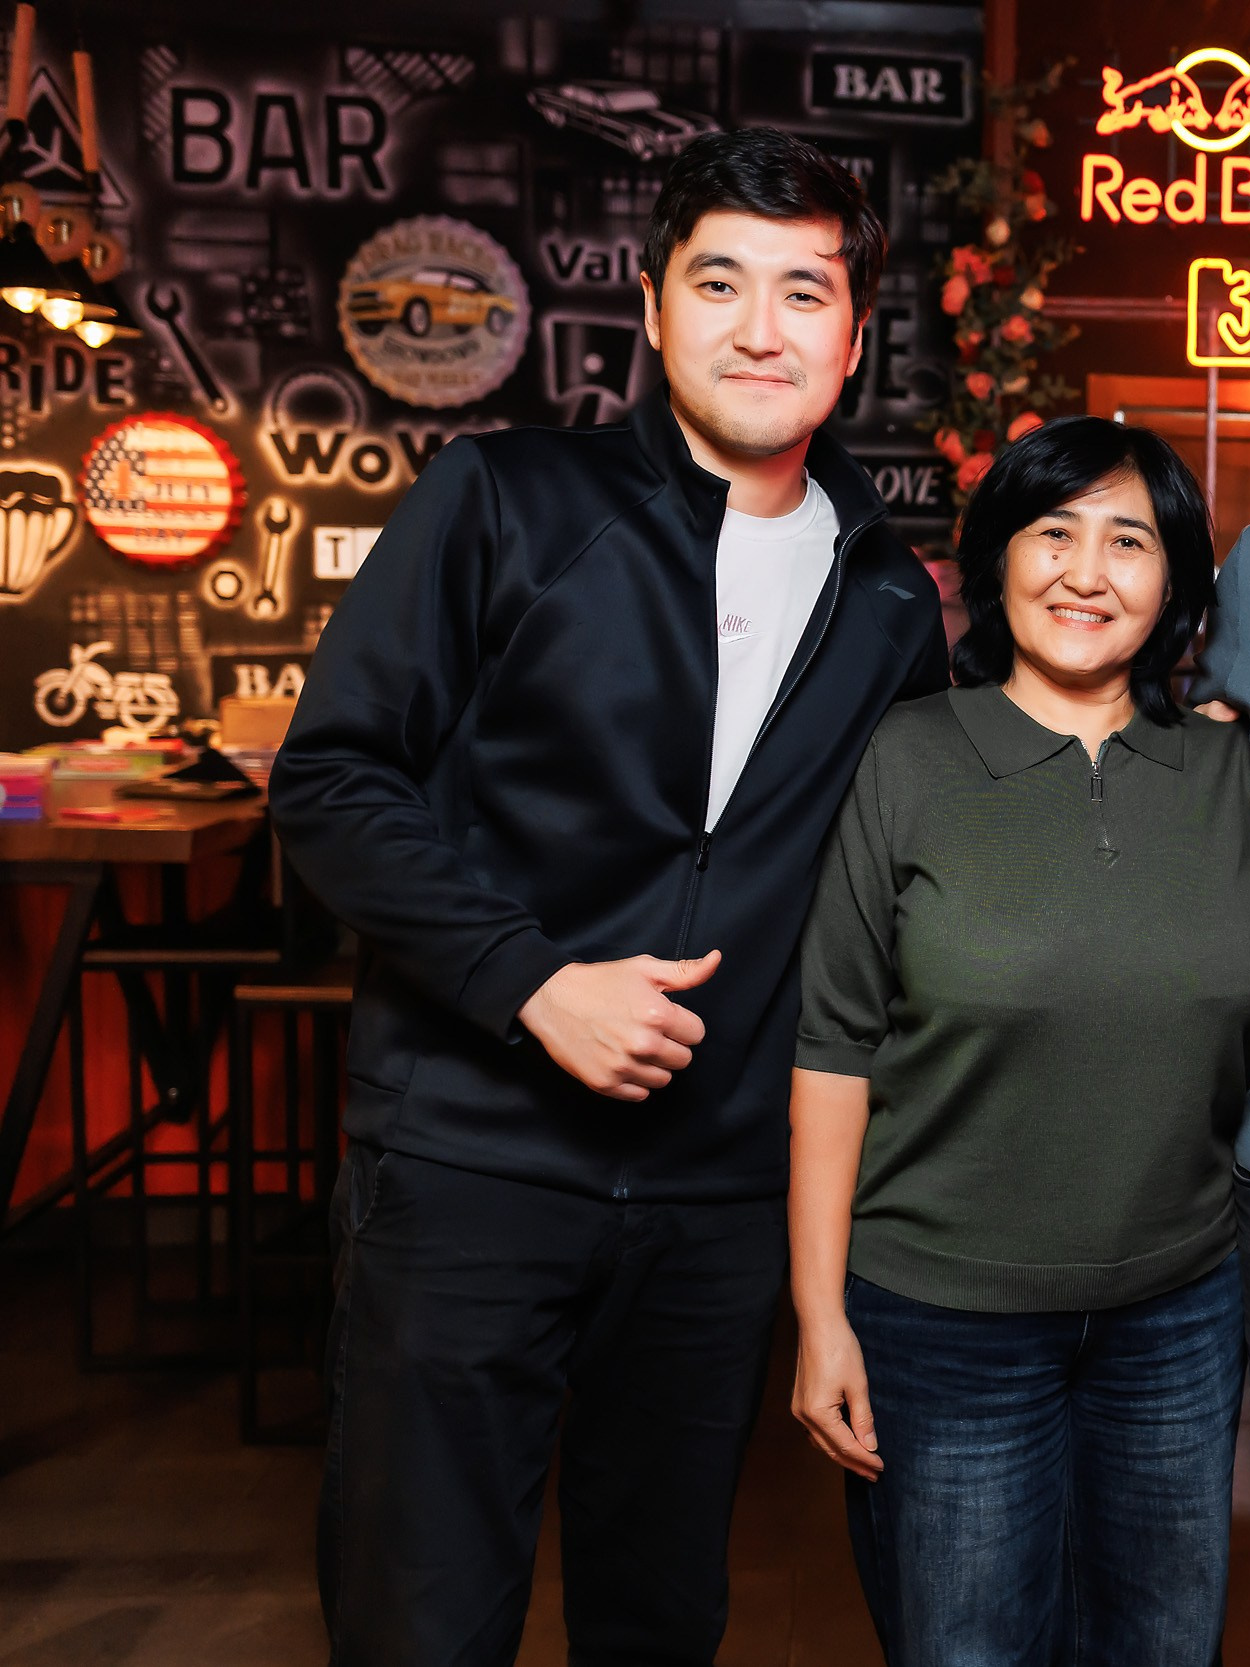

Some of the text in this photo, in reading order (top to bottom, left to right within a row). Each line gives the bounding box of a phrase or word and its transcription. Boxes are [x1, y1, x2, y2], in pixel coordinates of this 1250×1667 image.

[833, 64, 946, 103] BAR
[171, 88, 387, 190] BAR
[1081, 152, 1207, 224] Red
[548, 243, 646, 282] Val
[863, 464, 943, 506] OVE
[722, 613, 753, 634] NIKE
